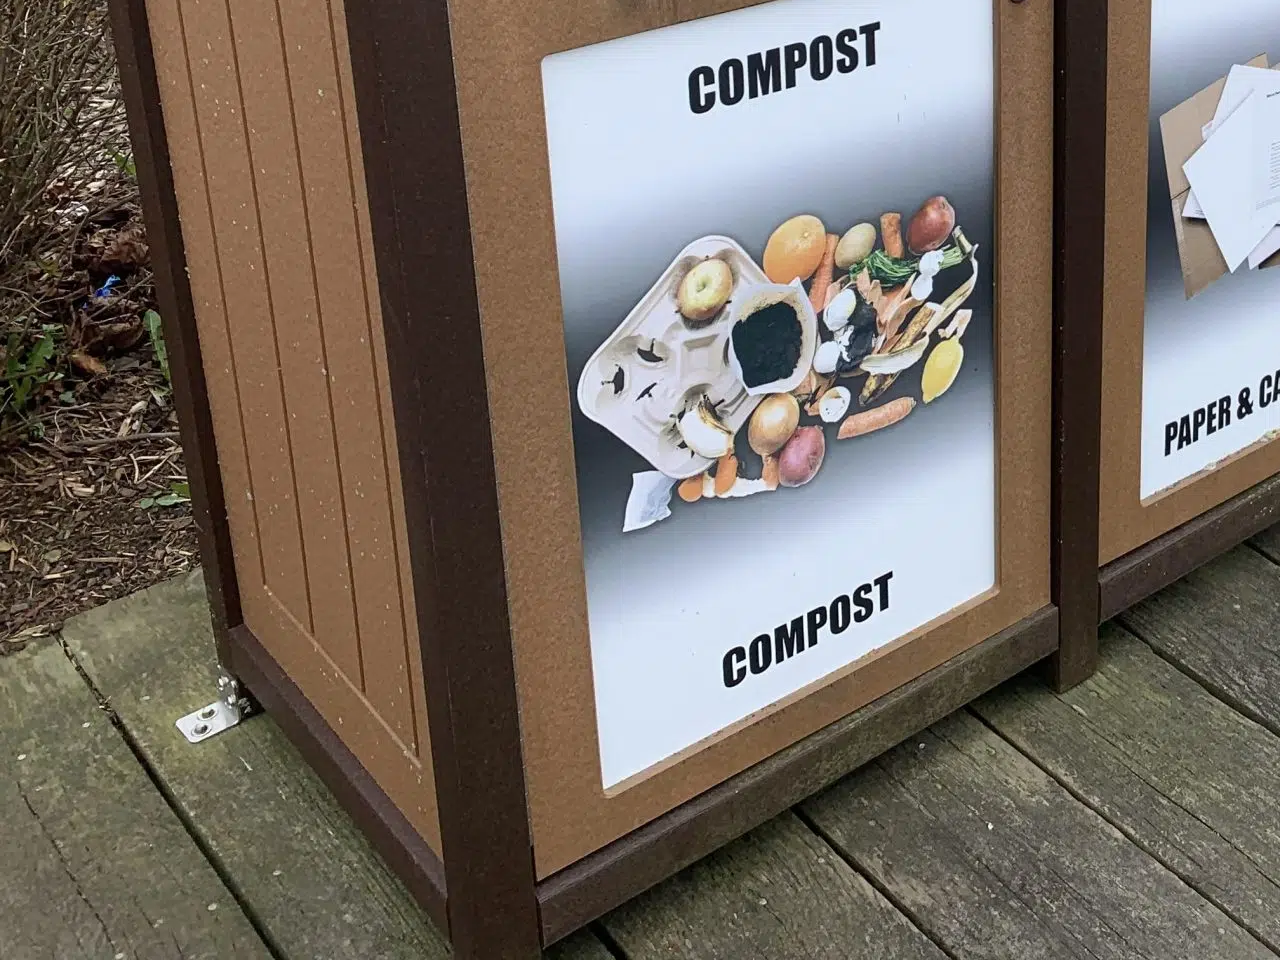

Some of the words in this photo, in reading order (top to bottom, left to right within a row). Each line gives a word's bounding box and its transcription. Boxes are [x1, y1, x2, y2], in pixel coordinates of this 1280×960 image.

[688, 21, 881, 115] COMPOST
[1164, 395, 1232, 457] PAPER
[1236, 386, 1254, 420] &
[722, 570, 894, 689] COMPOST
